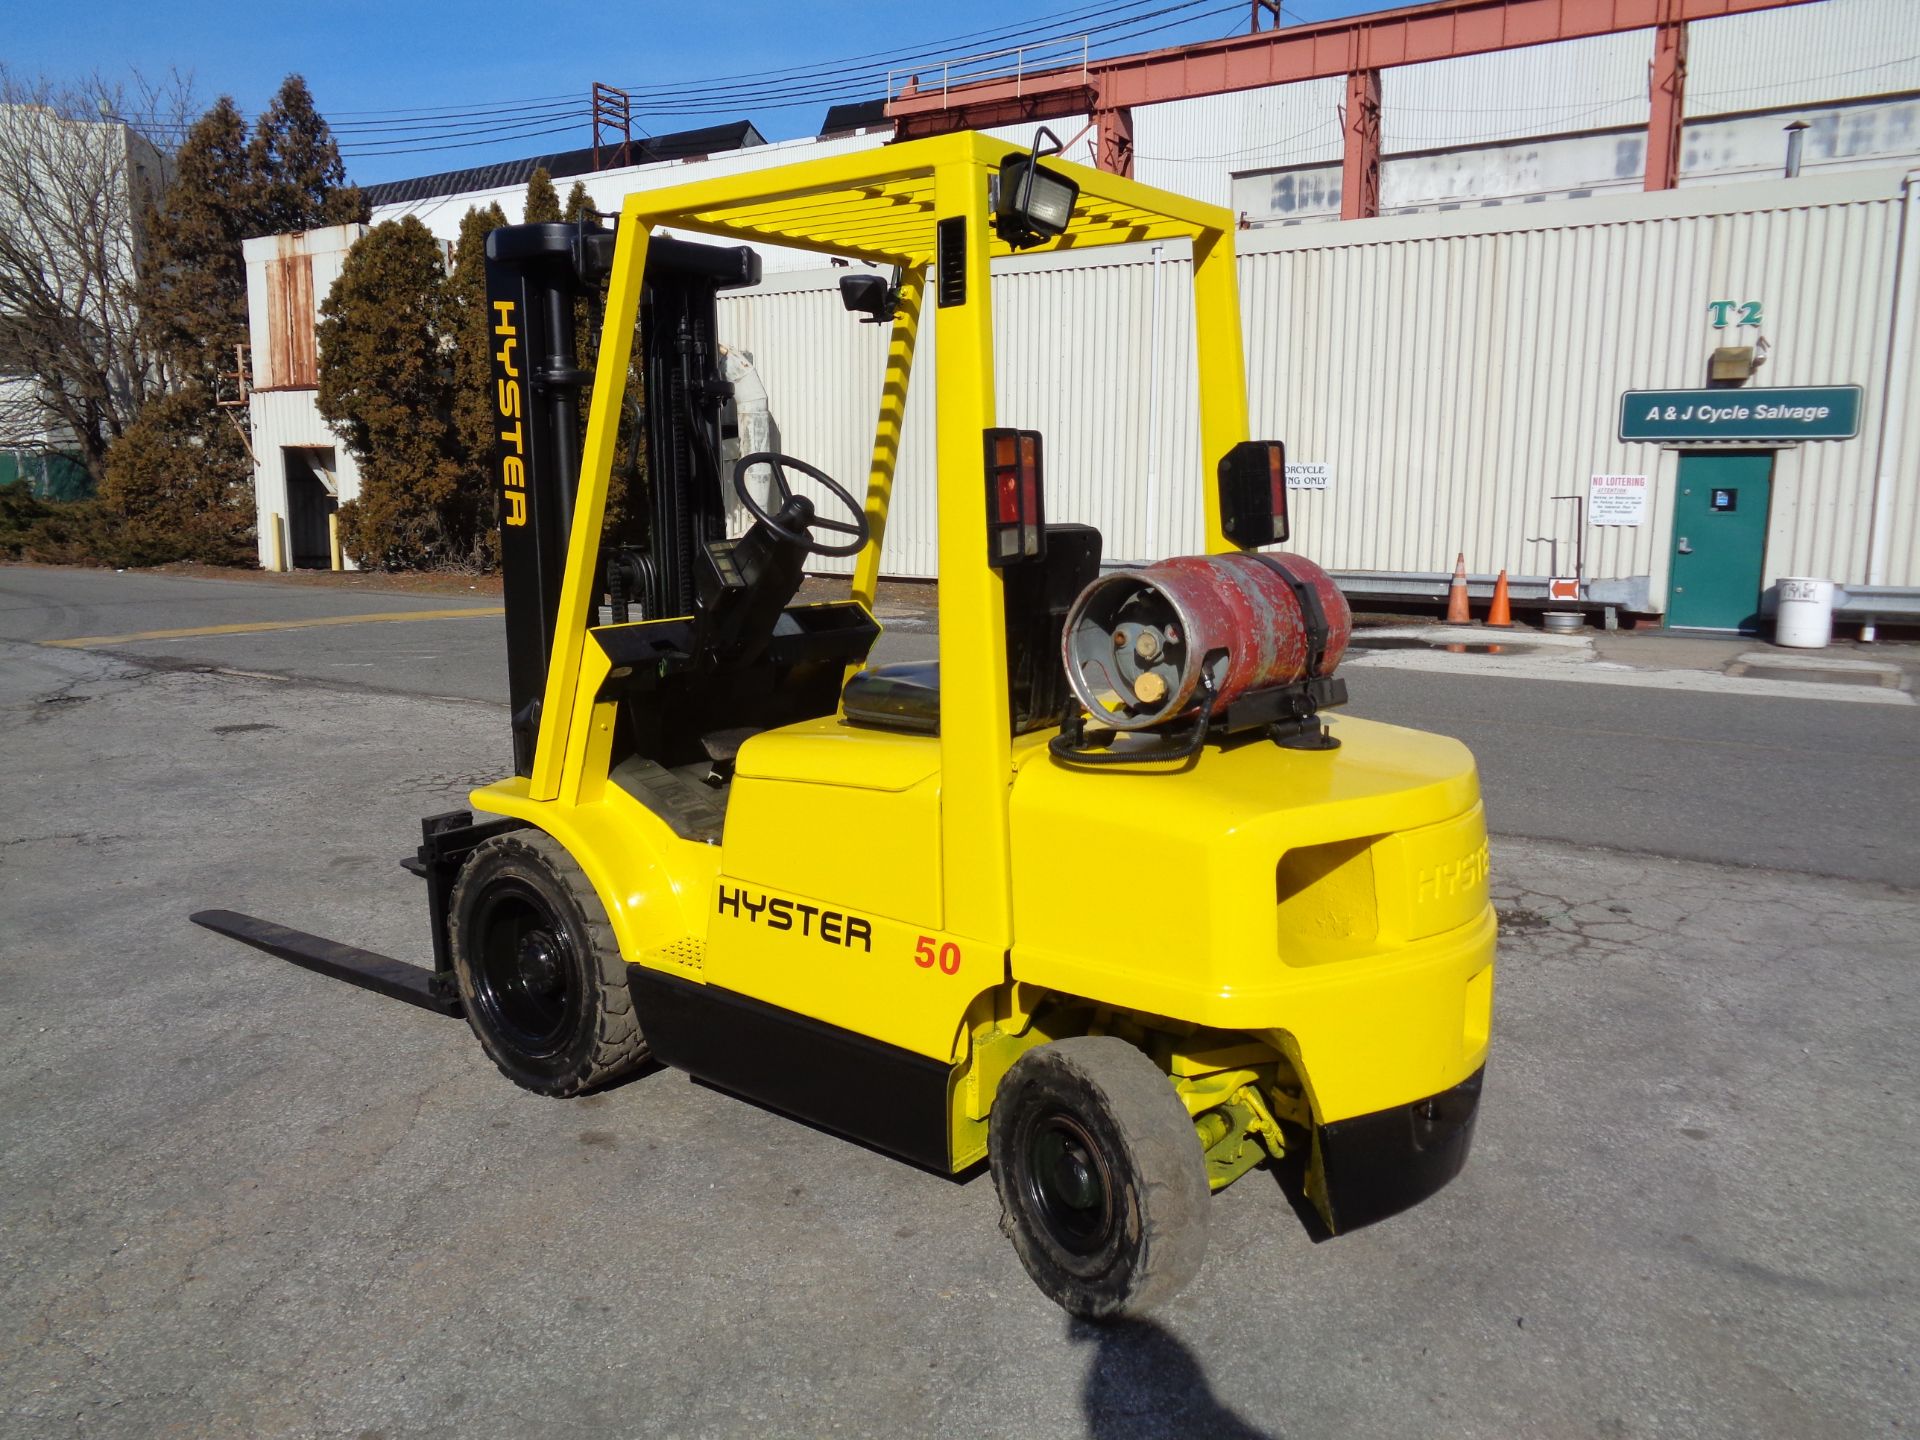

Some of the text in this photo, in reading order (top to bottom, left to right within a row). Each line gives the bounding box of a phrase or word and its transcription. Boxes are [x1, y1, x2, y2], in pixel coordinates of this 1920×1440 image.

[1708, 300, 1763, 327] T2
[494, 301, 527, 527] HYSTER
[1645, 404, 1829, 424] A & J Cycle Salvage
[1285, 466, 1325, 474] ORCYCLE
[1304, 477, 1328, 485] ONLY
[1592, 476, 1646, 487] NO LOITERING
[718, 884, 961, 976] HYSTER 50
